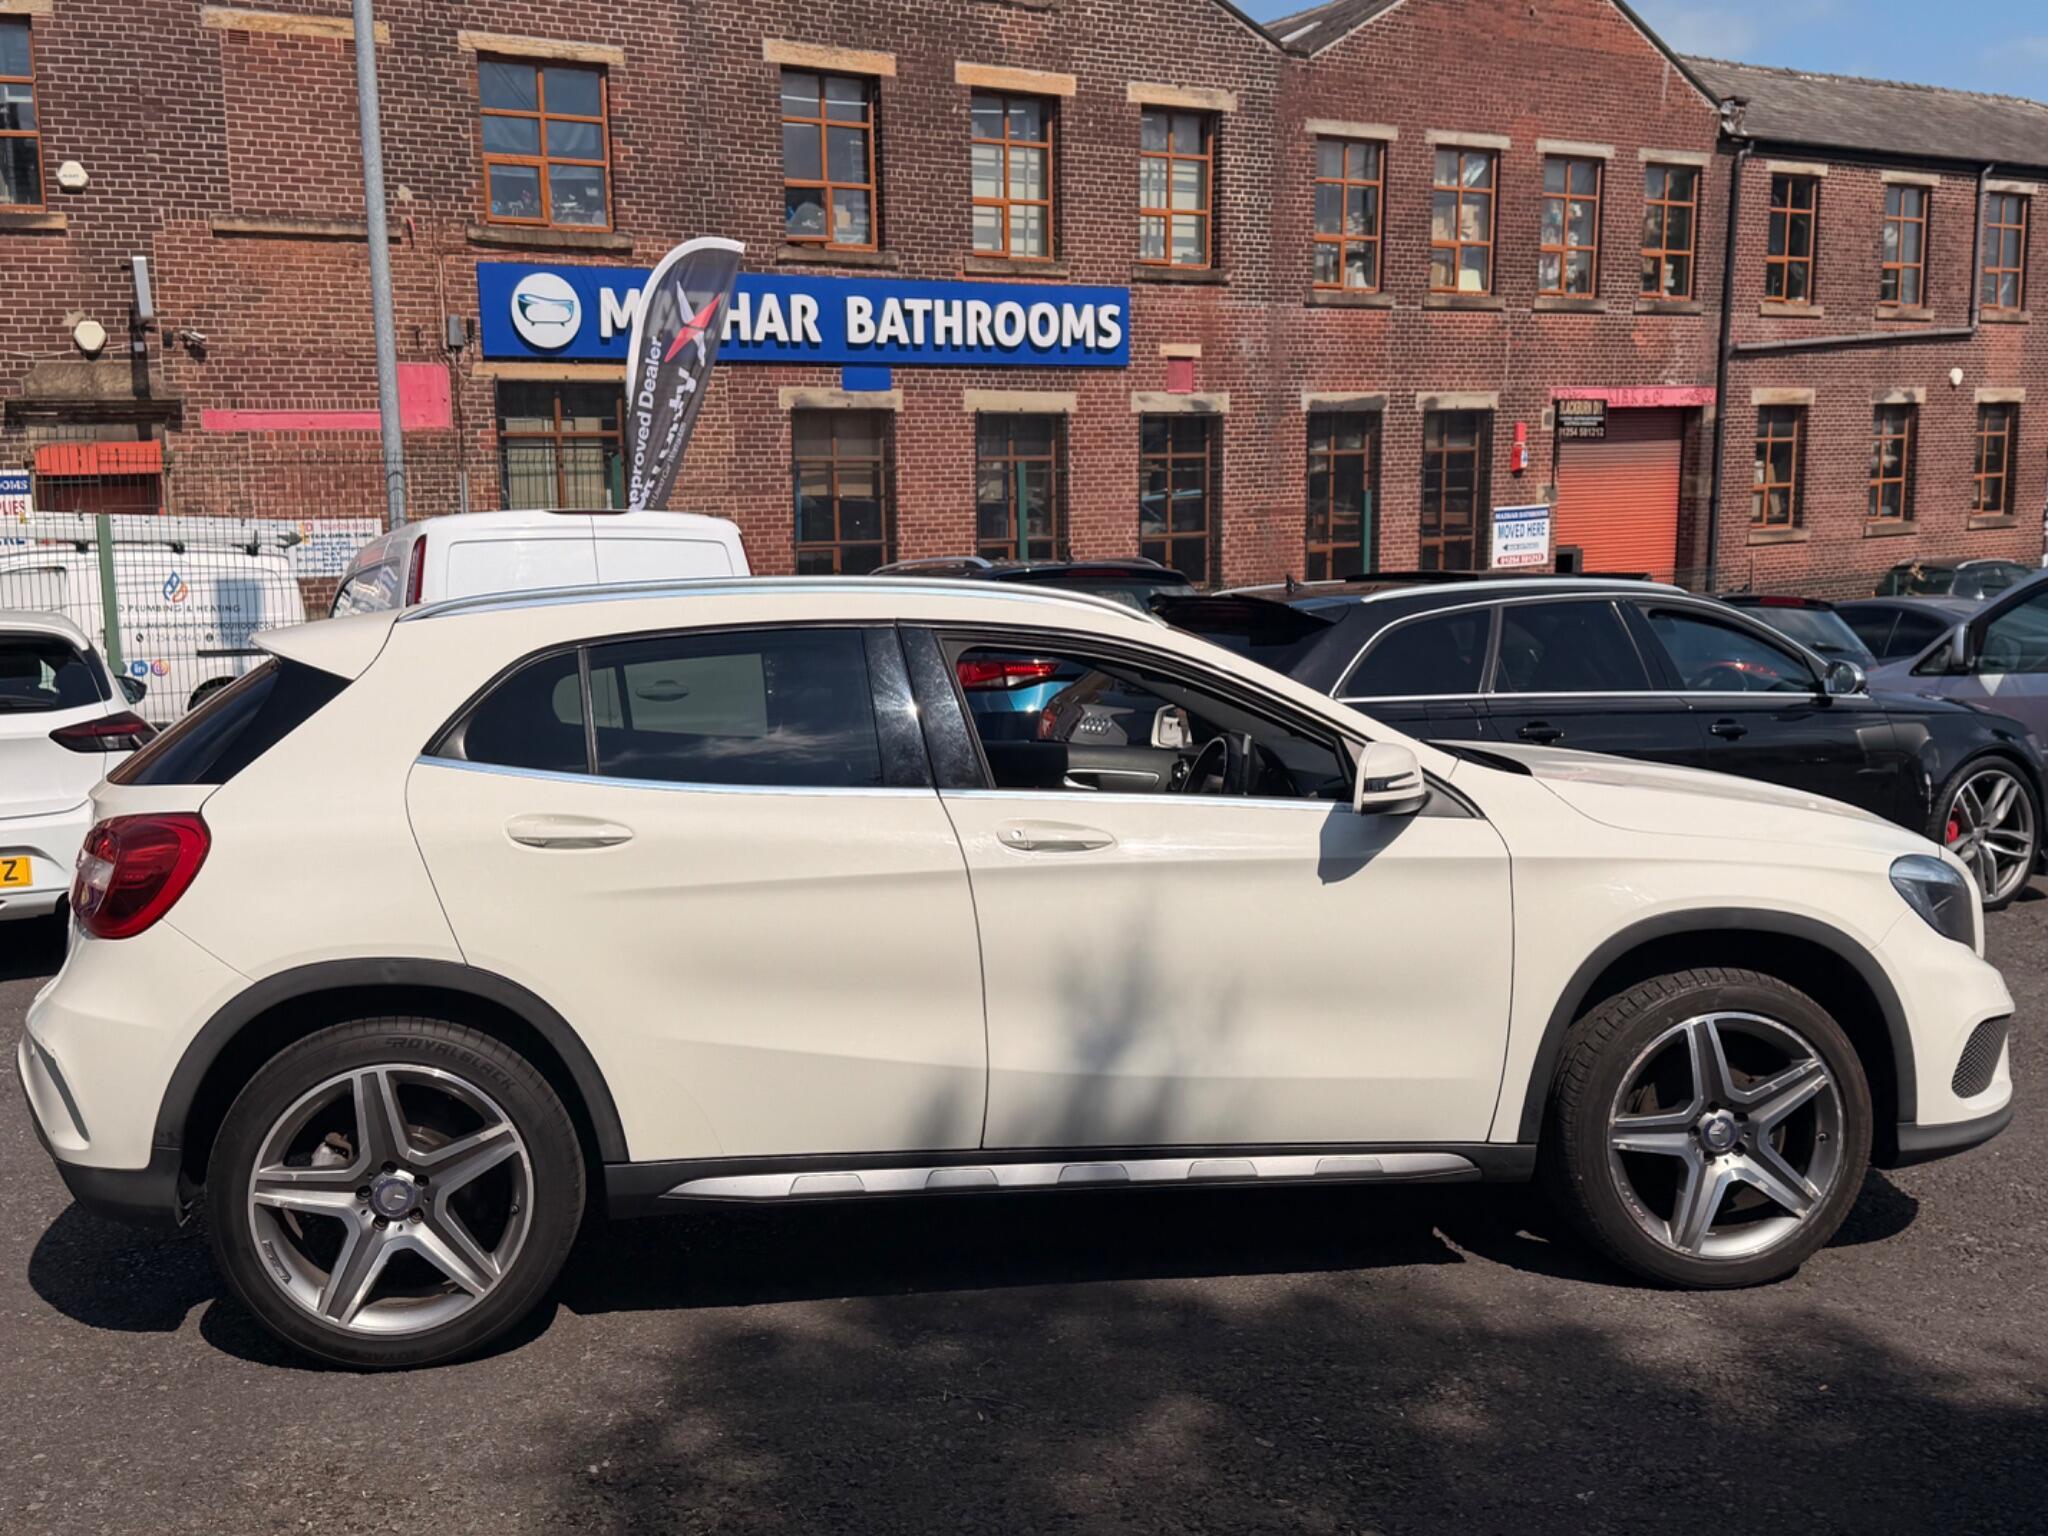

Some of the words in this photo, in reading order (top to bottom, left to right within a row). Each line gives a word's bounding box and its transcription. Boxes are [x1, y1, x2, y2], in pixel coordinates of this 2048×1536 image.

[845, 295, 1122, 348] BATHROOMS
[638, 335, 663, 409] Dealer
[1559, 400, 1592, 415] BLACKBURN
[0, 479, 28, 491] OMS
[0, 500, 25, 516] LIES
[1498, 523, 1525, 539] MOVED
[1527, 521, 1545, 537] HERE
[127, 604, 182, 613] PLUMBING
[186, 604, 193, 612] &
[196, 604, 241, 613] HEATING
[2, 860, 19, 881] Z
